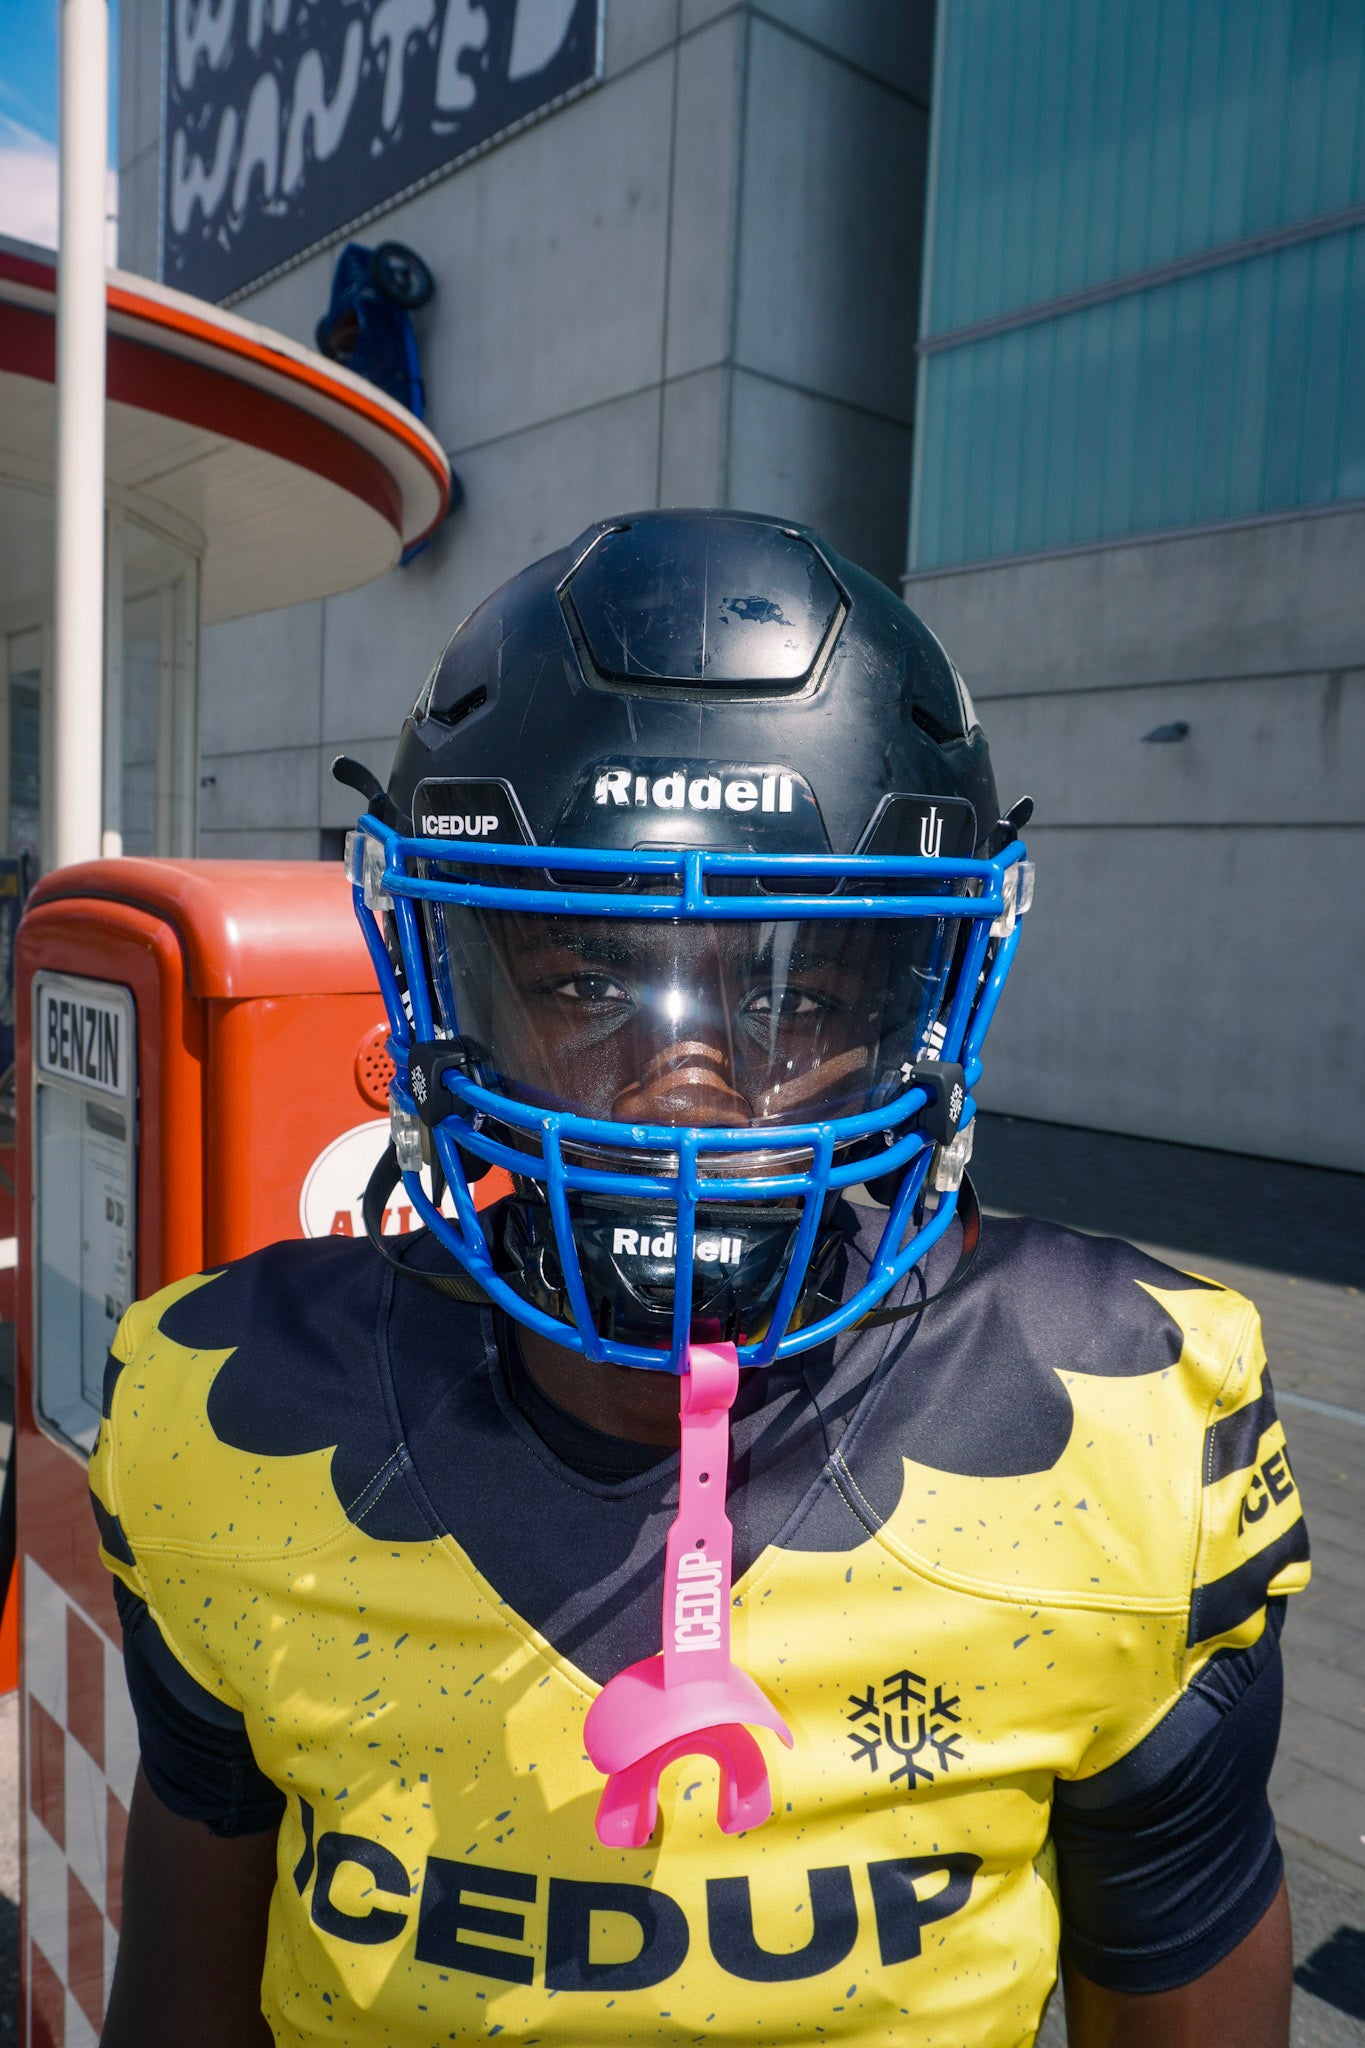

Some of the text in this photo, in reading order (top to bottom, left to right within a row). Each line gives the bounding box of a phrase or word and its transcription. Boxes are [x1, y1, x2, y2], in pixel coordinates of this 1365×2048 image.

[172, 0, 573, 233] WANTED
[422, 814, 499, 836] ICEDUP
[47, 997, 119, 1089] BENZIN
[613, 1227, 742, 1265] Ridell
[675, 1551, 723, 1653] ICEDUP
